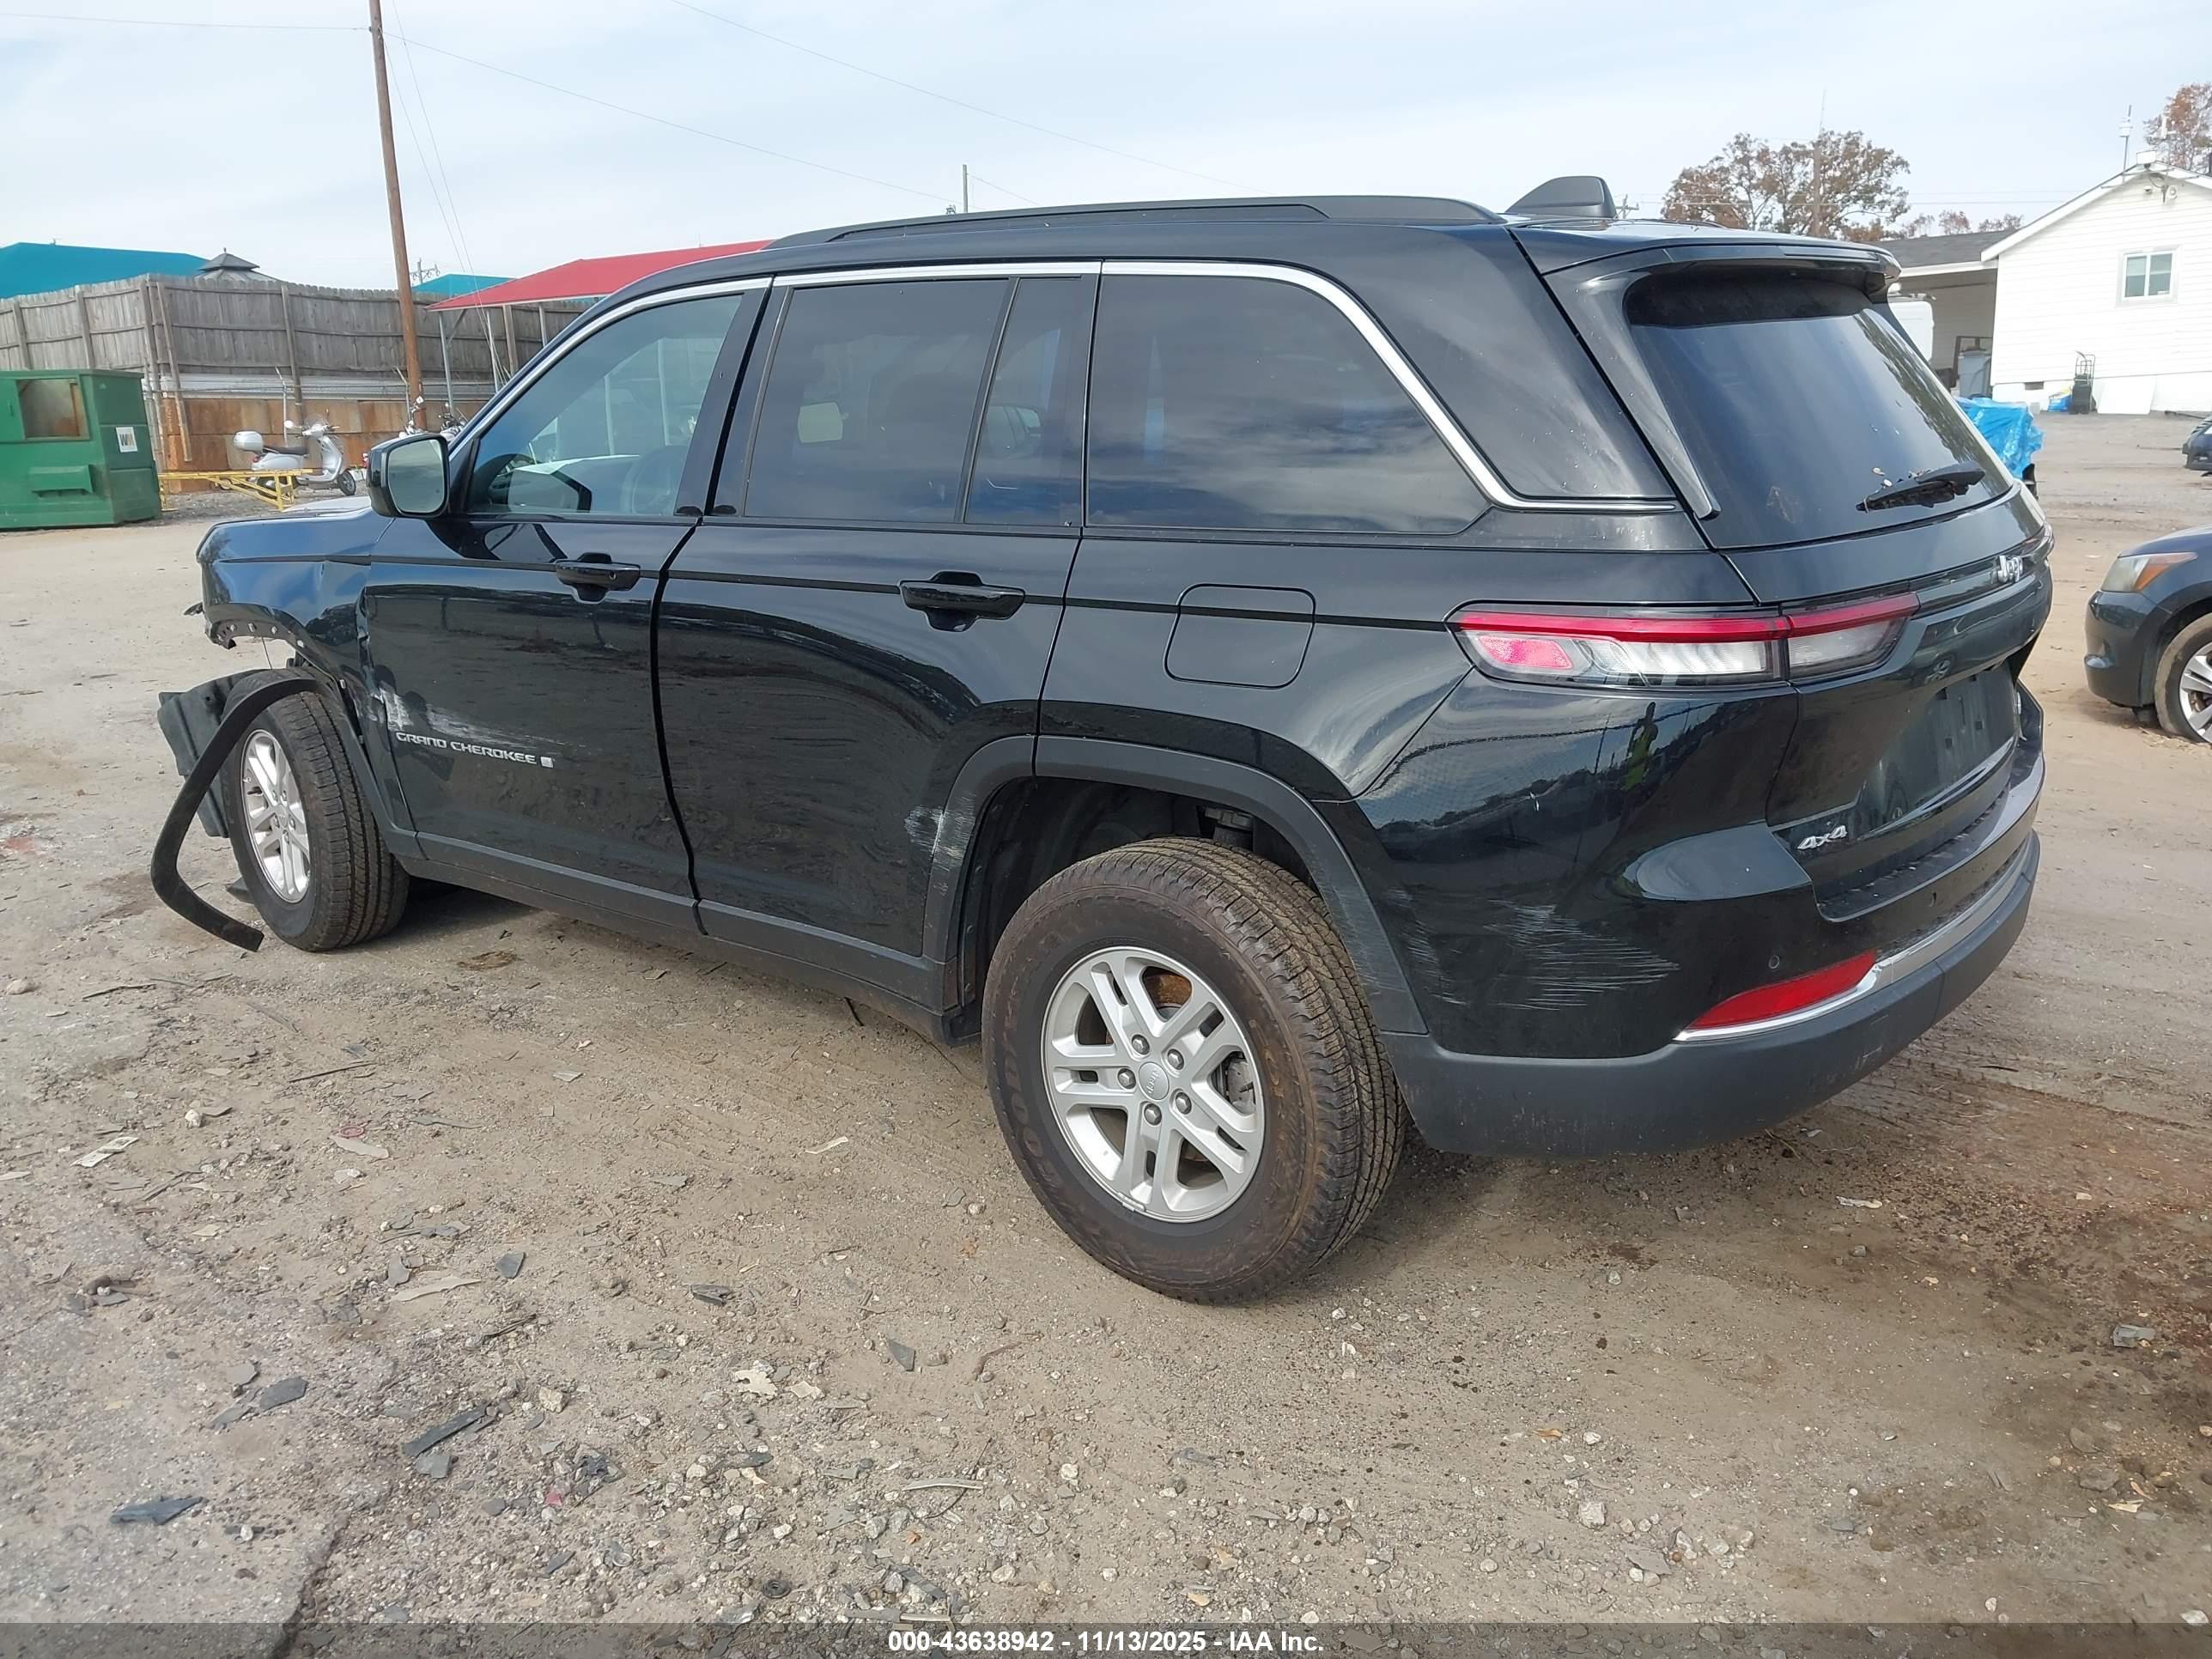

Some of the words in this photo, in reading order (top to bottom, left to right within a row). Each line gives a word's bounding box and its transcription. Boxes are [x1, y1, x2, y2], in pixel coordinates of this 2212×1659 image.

[395, 732, 447, 749] GRAND
[450, 741, 538, 765] CHEROKEE
[1796, 825, 1848, 850] 4x4
